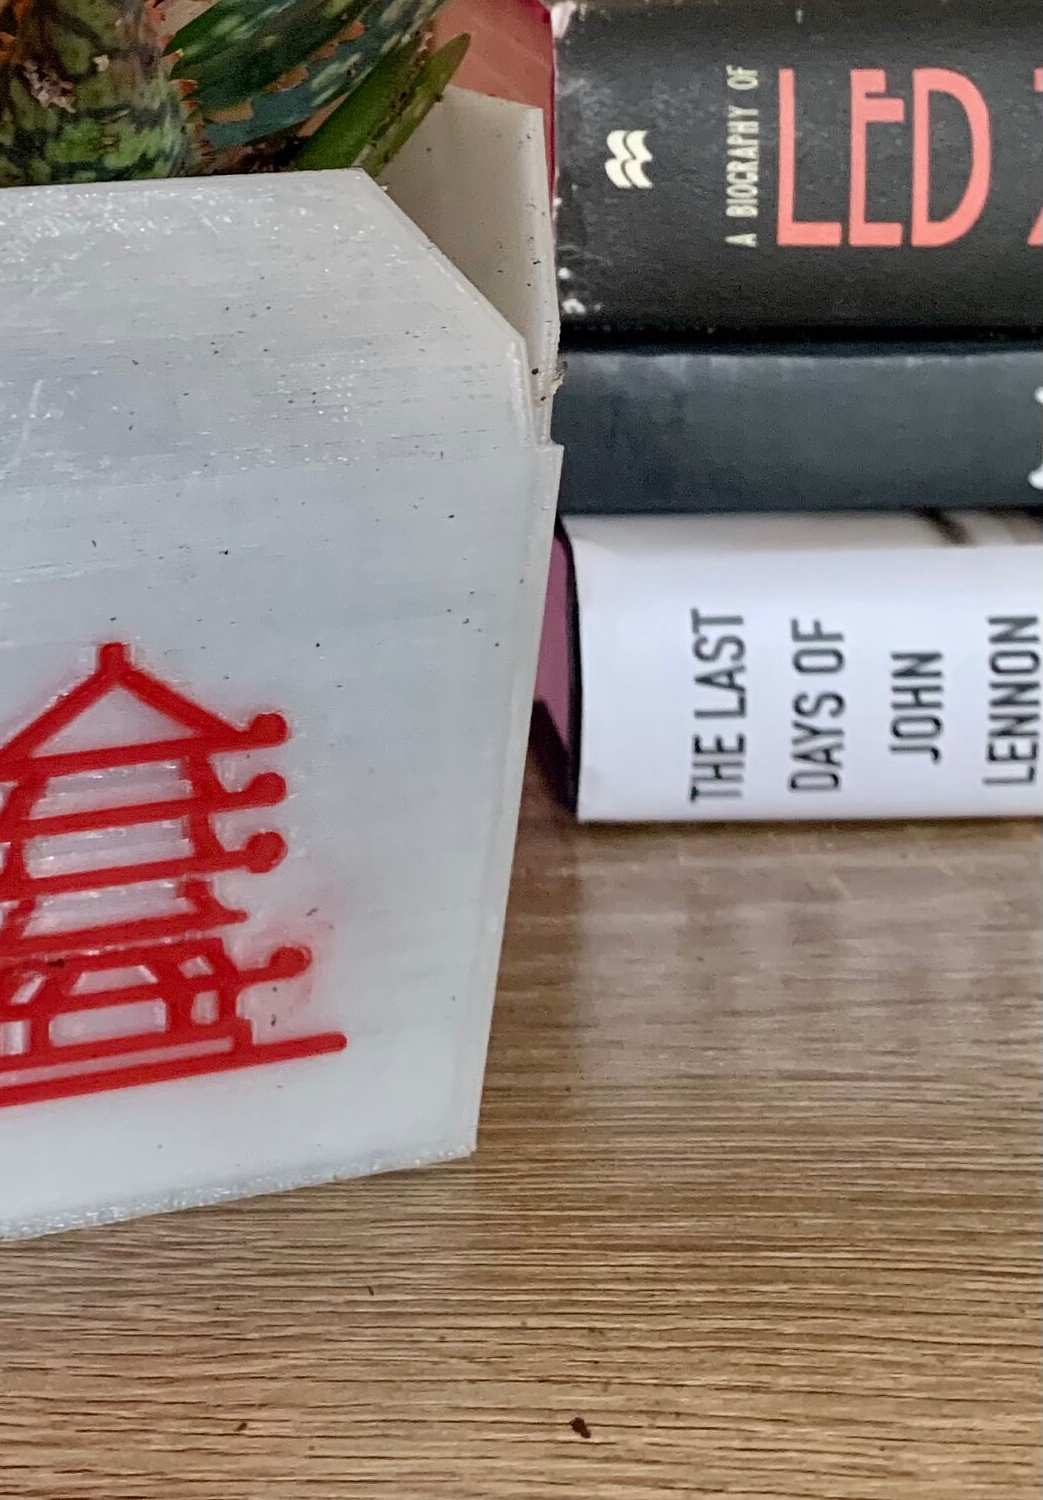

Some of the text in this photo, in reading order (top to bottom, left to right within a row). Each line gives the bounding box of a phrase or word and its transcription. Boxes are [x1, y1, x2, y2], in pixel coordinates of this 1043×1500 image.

[725, 64, 760, 248] A BIOGRAPHY OF
[776, 67, 992, 248] LED
[690, 607, 747, 805] THE LAST
[788, 617, 846, 793] DAYS OF
[888, 650, 944, 764] JOHN
[982, 614, 1042, 786] LENNON
